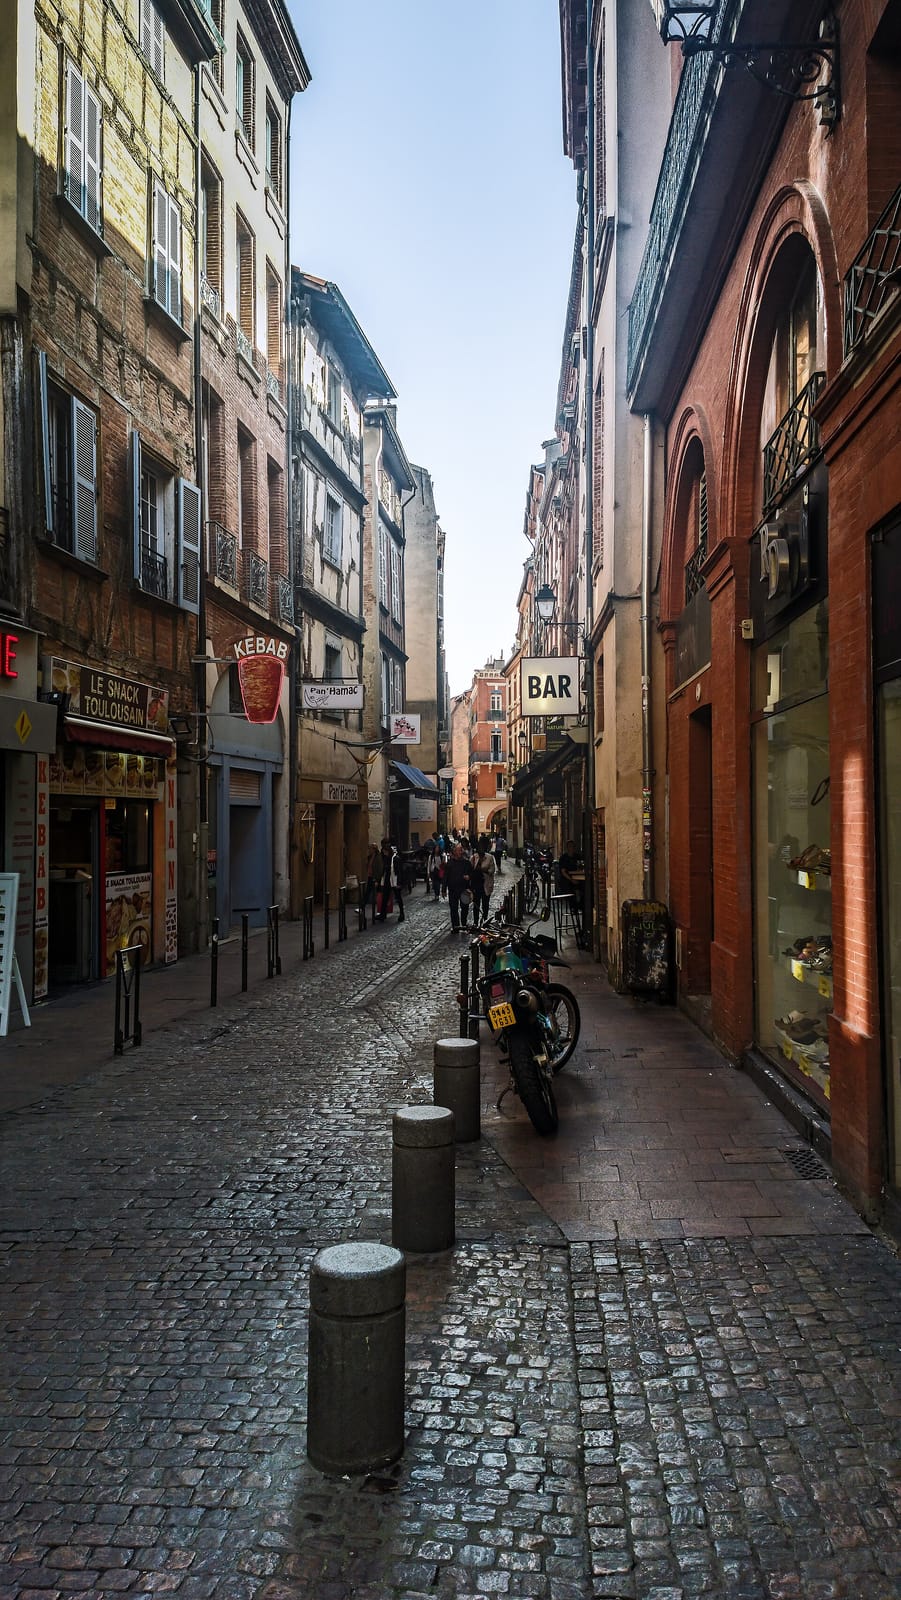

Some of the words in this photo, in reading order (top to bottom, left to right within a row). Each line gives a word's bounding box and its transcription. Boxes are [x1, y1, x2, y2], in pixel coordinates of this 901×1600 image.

[233, 637, 289, 659] KEBAB
[90, 674, 104, 696] LE
[107, 678, 140, 705] SNACK
[310, 685, 358, 697] Pan'Hamac
[528, 674, 572, 699] BAR
[84, 695, 144, 726] TOULOUSAIN
[328, 783, 358, 802] Pan'Hamac
[36, 760, 47, 910] KEBAB
